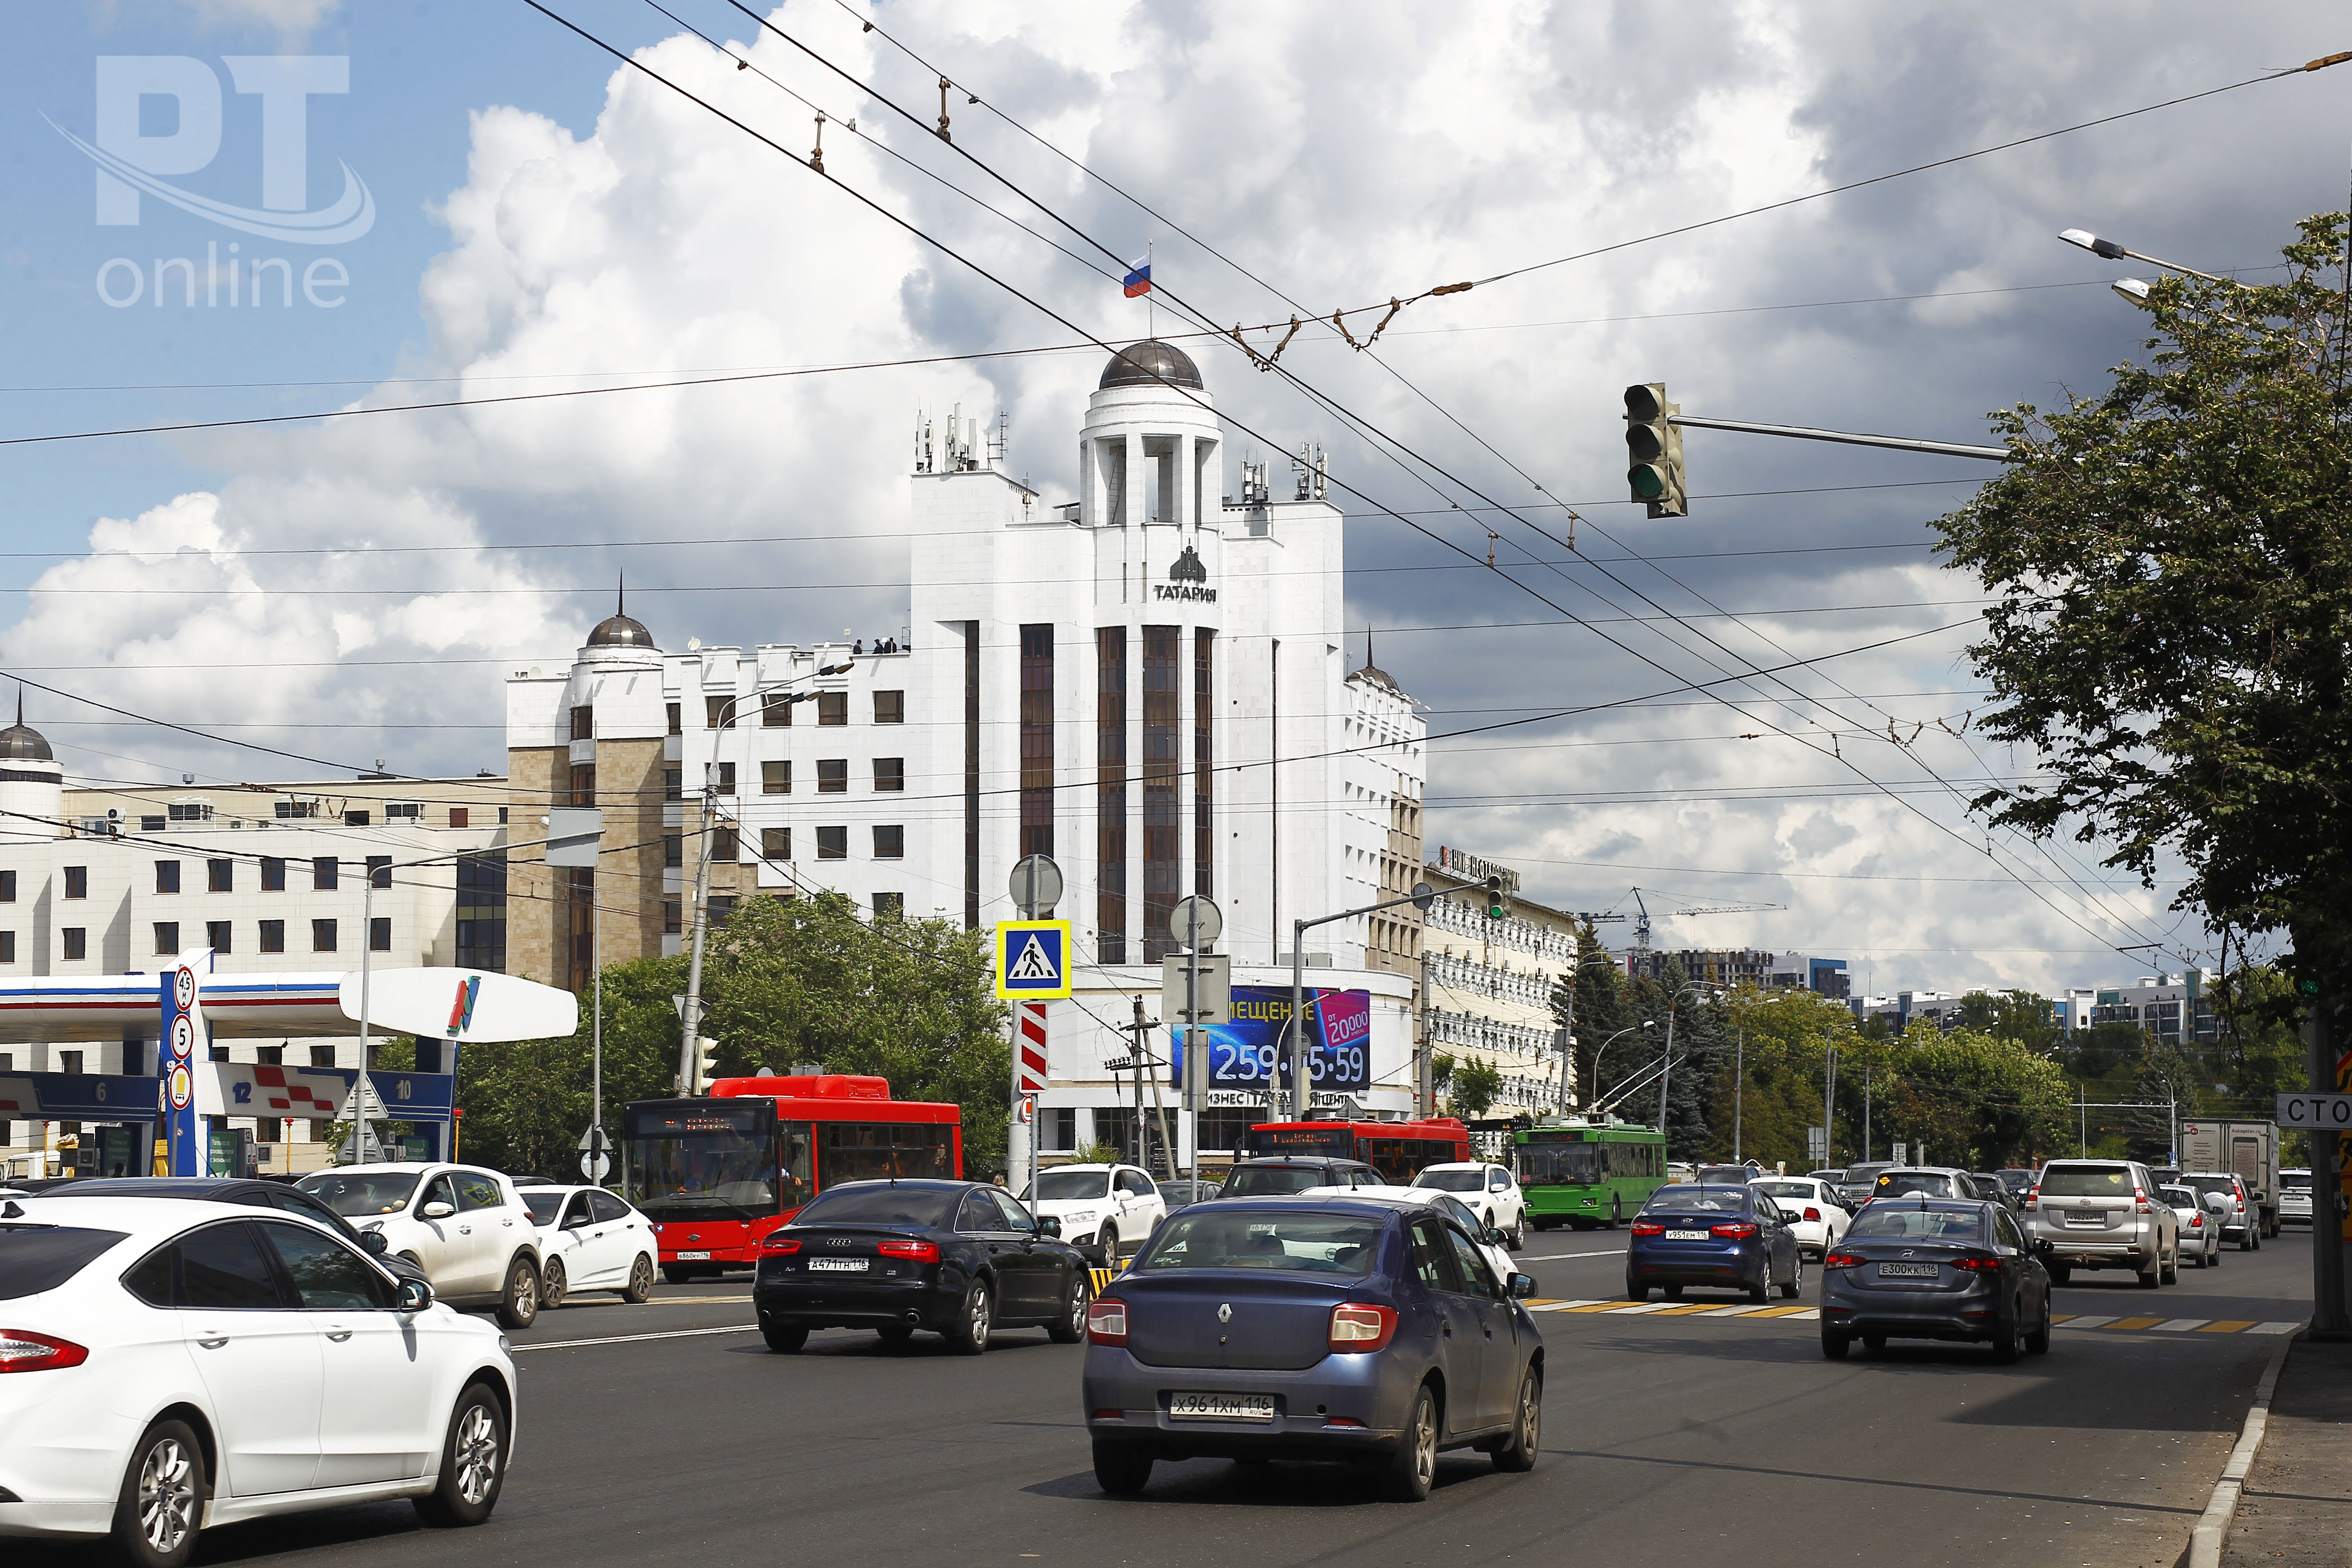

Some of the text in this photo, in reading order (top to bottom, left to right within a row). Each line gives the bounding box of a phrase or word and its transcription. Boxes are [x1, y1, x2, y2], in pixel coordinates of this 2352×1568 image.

[1154, 585, 1216, 602] ТАТАРИЯ
[1329, 1011, 1368, 1043] 20000
[179, 1028, 186, 1045] 5
[96, 1082, 106, 1102] 6
[233, 1081, 252, 1103] 12
[395, 1079, 411, 1100] 10
[852, 1259, 866, 1267] 116
[1245, 1396, 1269, 1410] 116
